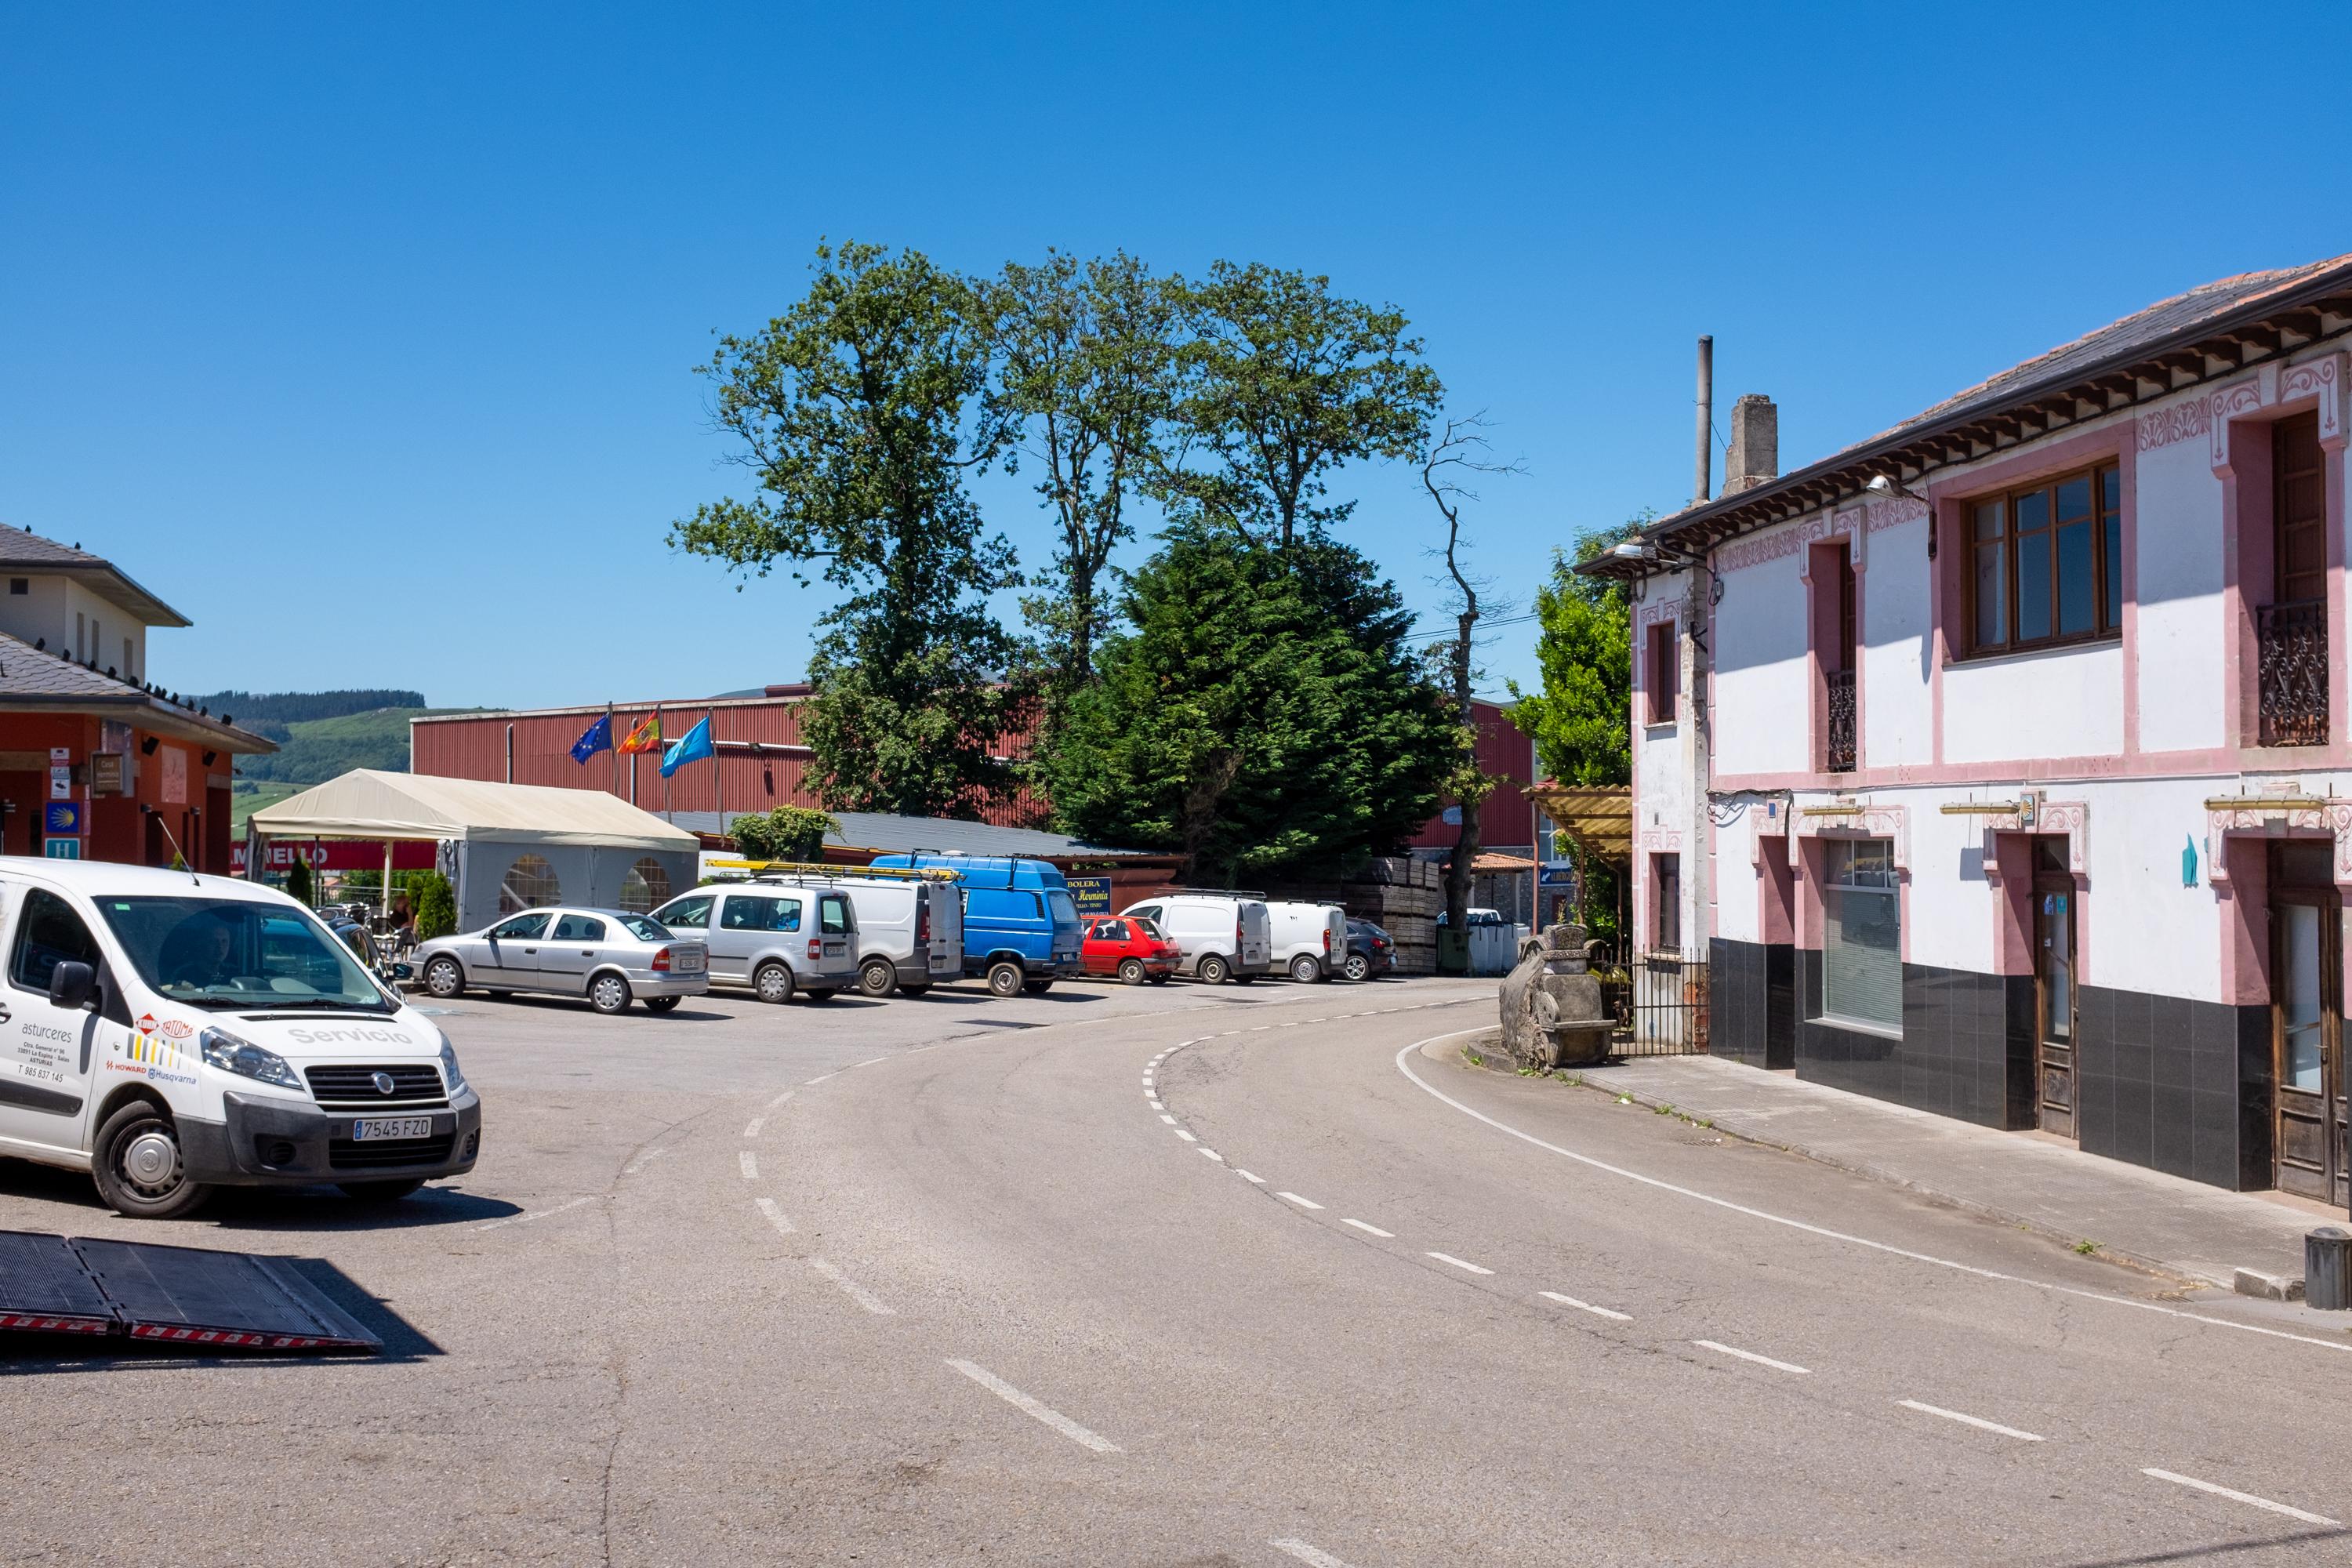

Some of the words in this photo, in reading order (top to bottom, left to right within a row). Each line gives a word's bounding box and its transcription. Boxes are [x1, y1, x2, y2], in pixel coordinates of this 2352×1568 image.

[56, 843, 69, 858] H
[1078, 890, 1108, 901] Herminia
[22, 1023, 72, 1043] asturceres
[162, 1019, 194, 1035] TATOMA
[288, 1028, 412, 1044] Servicio
[36, 1044, 53, 1052] General
[30, 1057, 53, 1067] ASTURIAS
[115, 1063, 147, 1074] HOWARD
[18, 1065, 24, 1074] T
[24, 1066, 38, 1077] 985
[38, 1069, 51, 1080] 837
[52, 1072, 64, 1083] 145
[156, 1069, 197, 1085] Husqvarna
[365, 1121, 400, 1138] 7545
[403, 1120, 429, 1135] FZD
